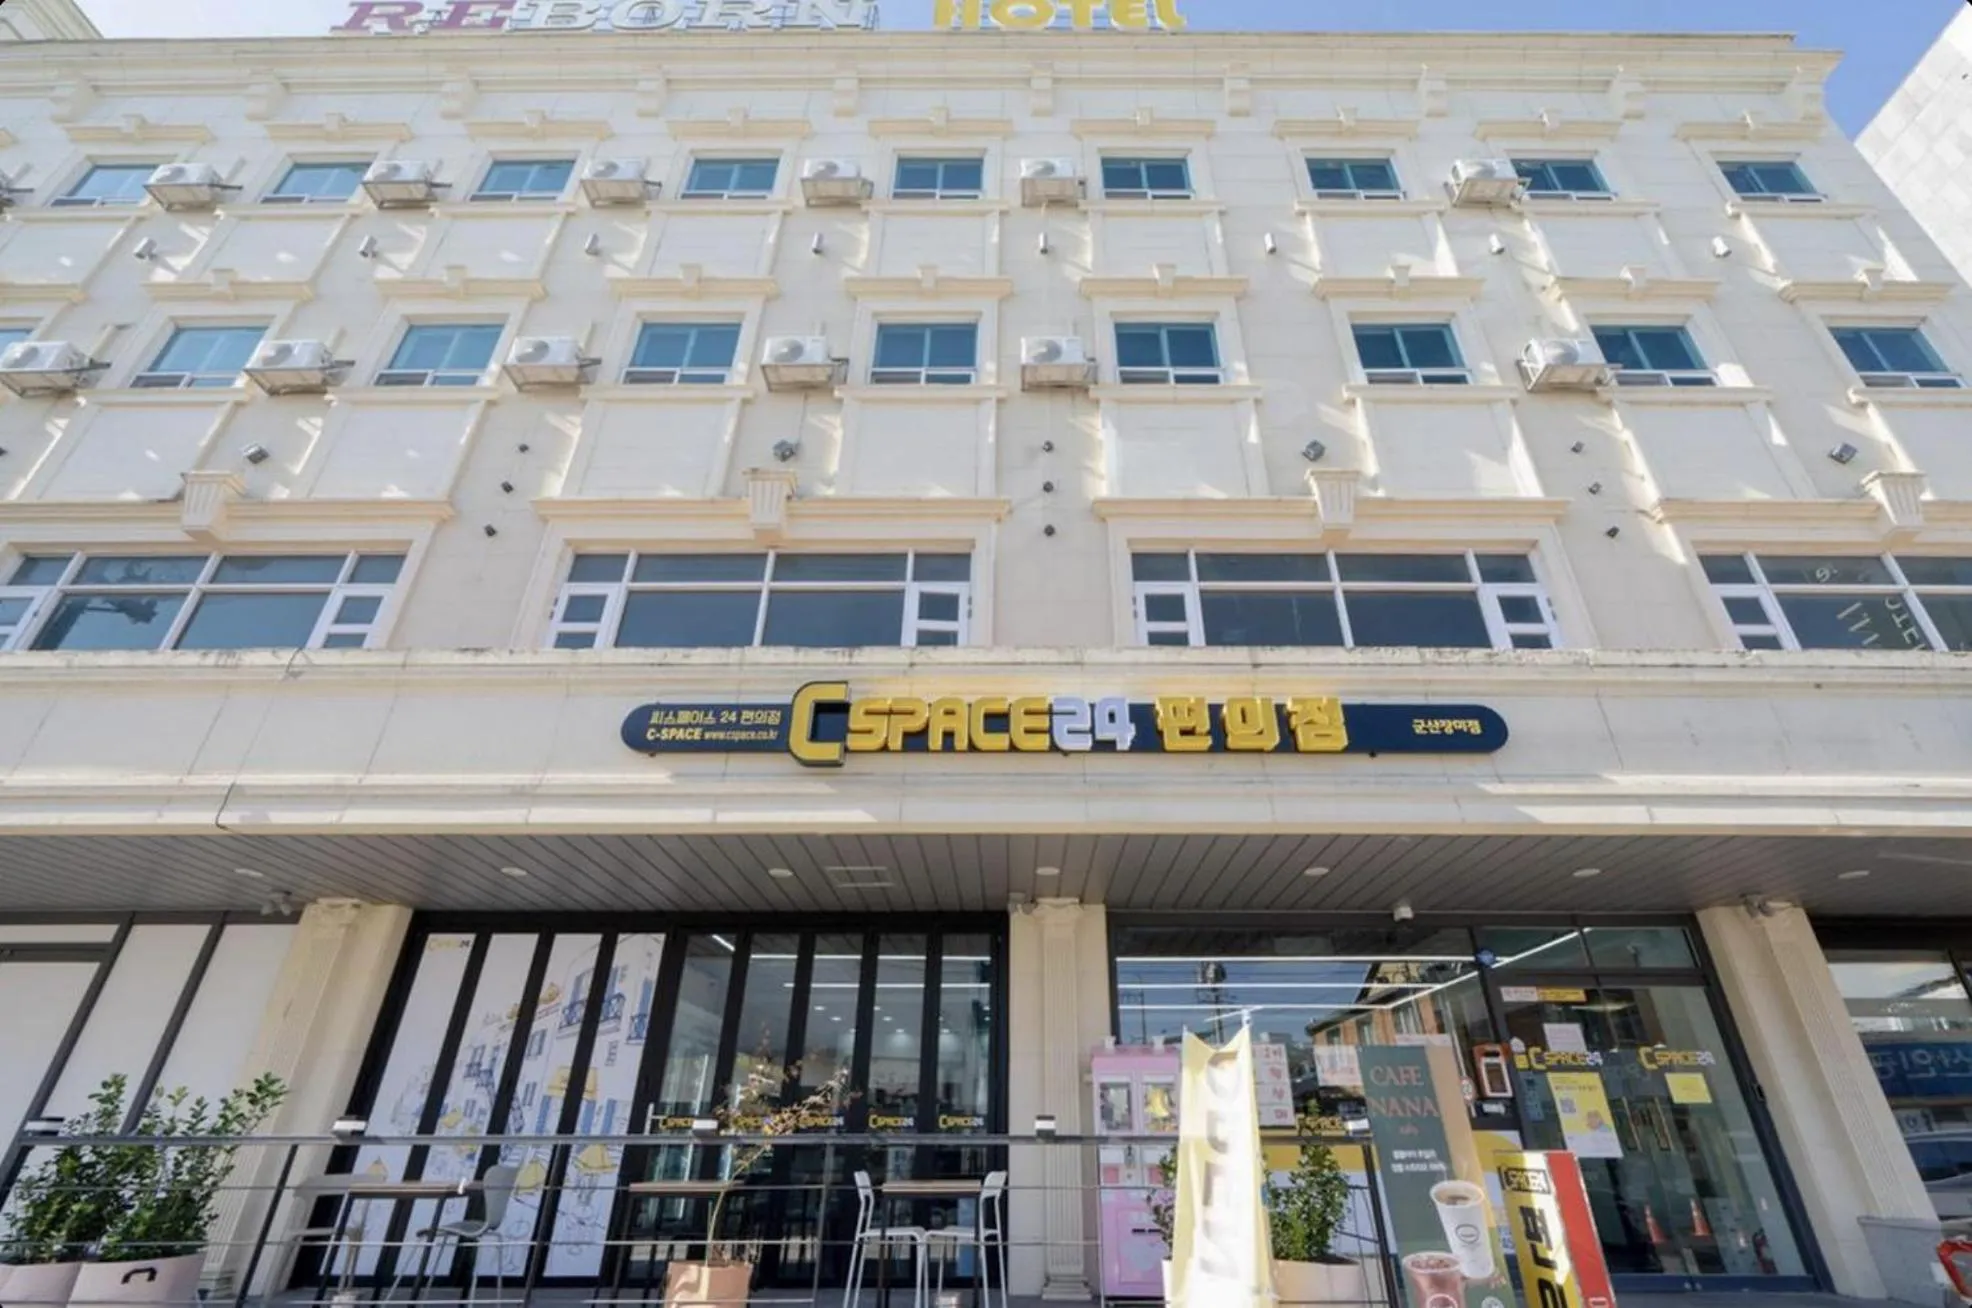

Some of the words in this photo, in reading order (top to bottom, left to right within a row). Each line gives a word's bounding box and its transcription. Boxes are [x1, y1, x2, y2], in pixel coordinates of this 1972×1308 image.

[329, 0, 868, 34] REBORN
[933, 0, 1187, 31] HOTEL
[720, 709, 737, 723] 24
[740, 709, 782, 725] 편의점
[1154, 696, 1347, 753] 편의점
[646, 728, 702, 740] C-SPACE
[1369, 1065, 1425, 1086] CAFE
[1367, 1096, 1441, 1118] NANA
